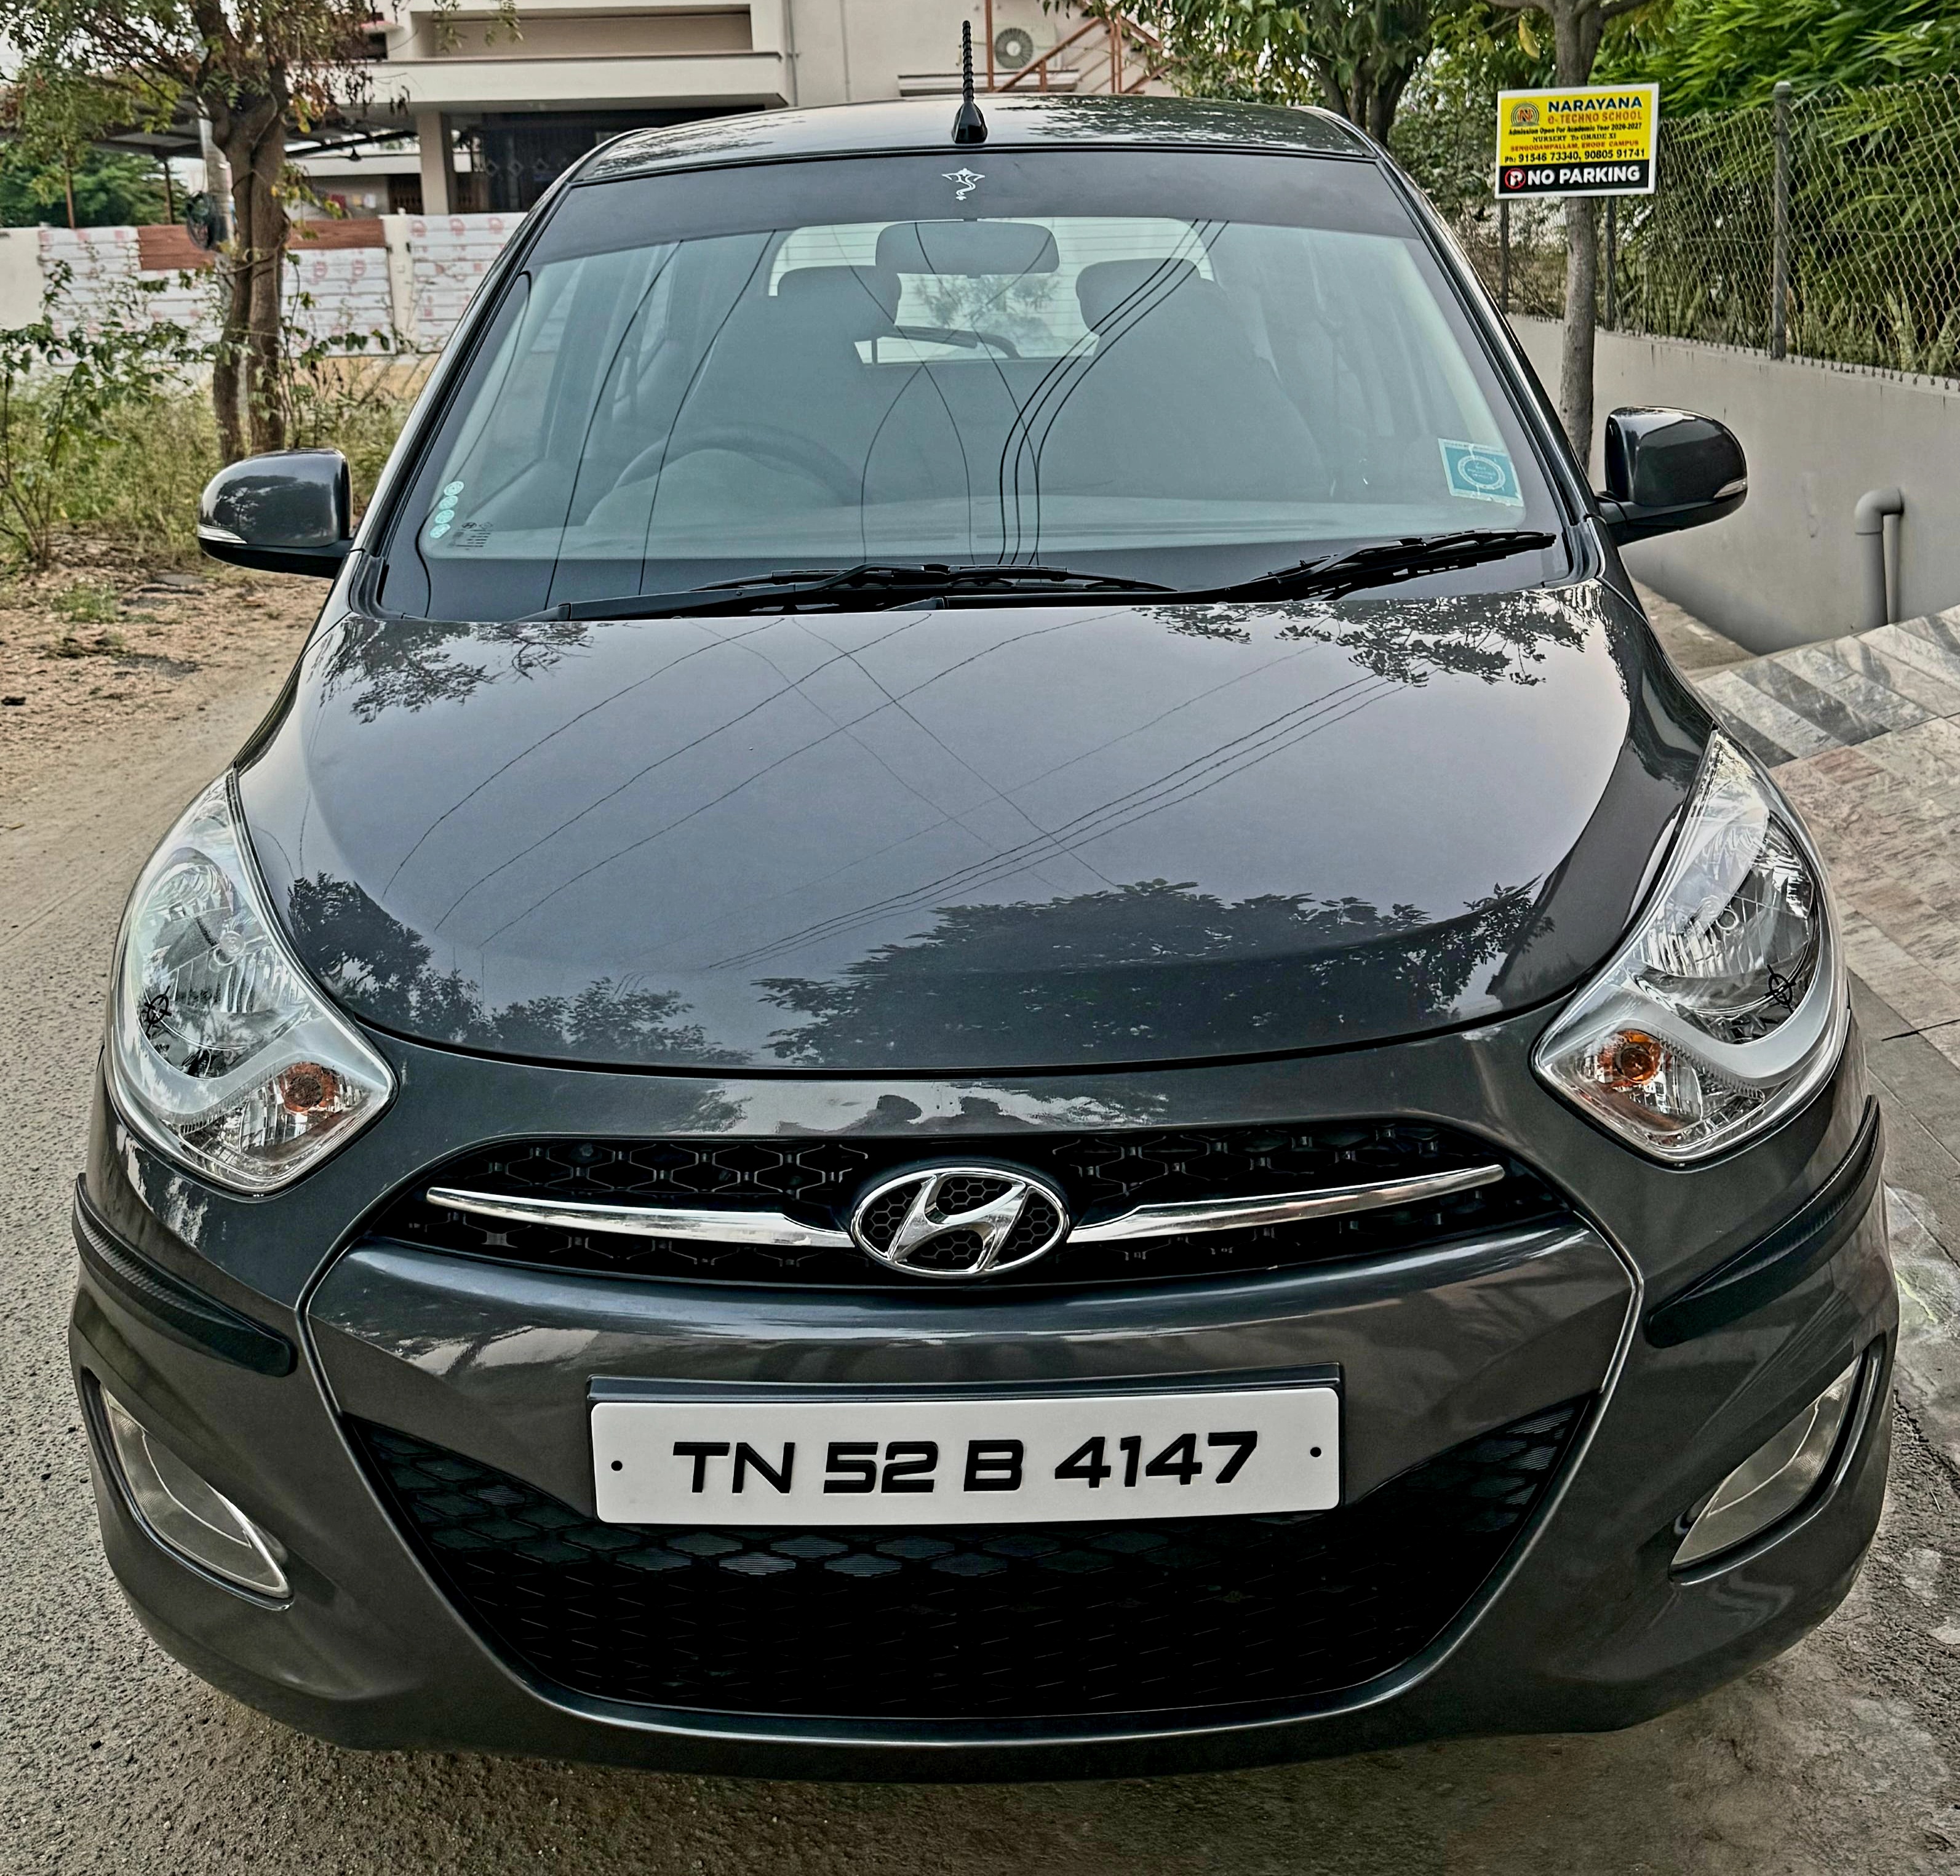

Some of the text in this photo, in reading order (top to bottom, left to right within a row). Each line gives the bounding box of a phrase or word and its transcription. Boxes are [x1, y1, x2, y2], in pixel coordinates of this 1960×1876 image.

[1548, 96, 1643, 113] NARAYANA
[1560, 113, 1599, 124] TECHNO
[1602, 111, 1642, 122] SCHOOL
[1518, 153, 1547, 162] 91546
[1585, 150, 1613, 159] 90805
[1617, 148, 1644, 158] 91741
[1528, 165, 1640, 185] NO PARKING
[672, 1431, 1258, 1494] TN 52 B 4147
